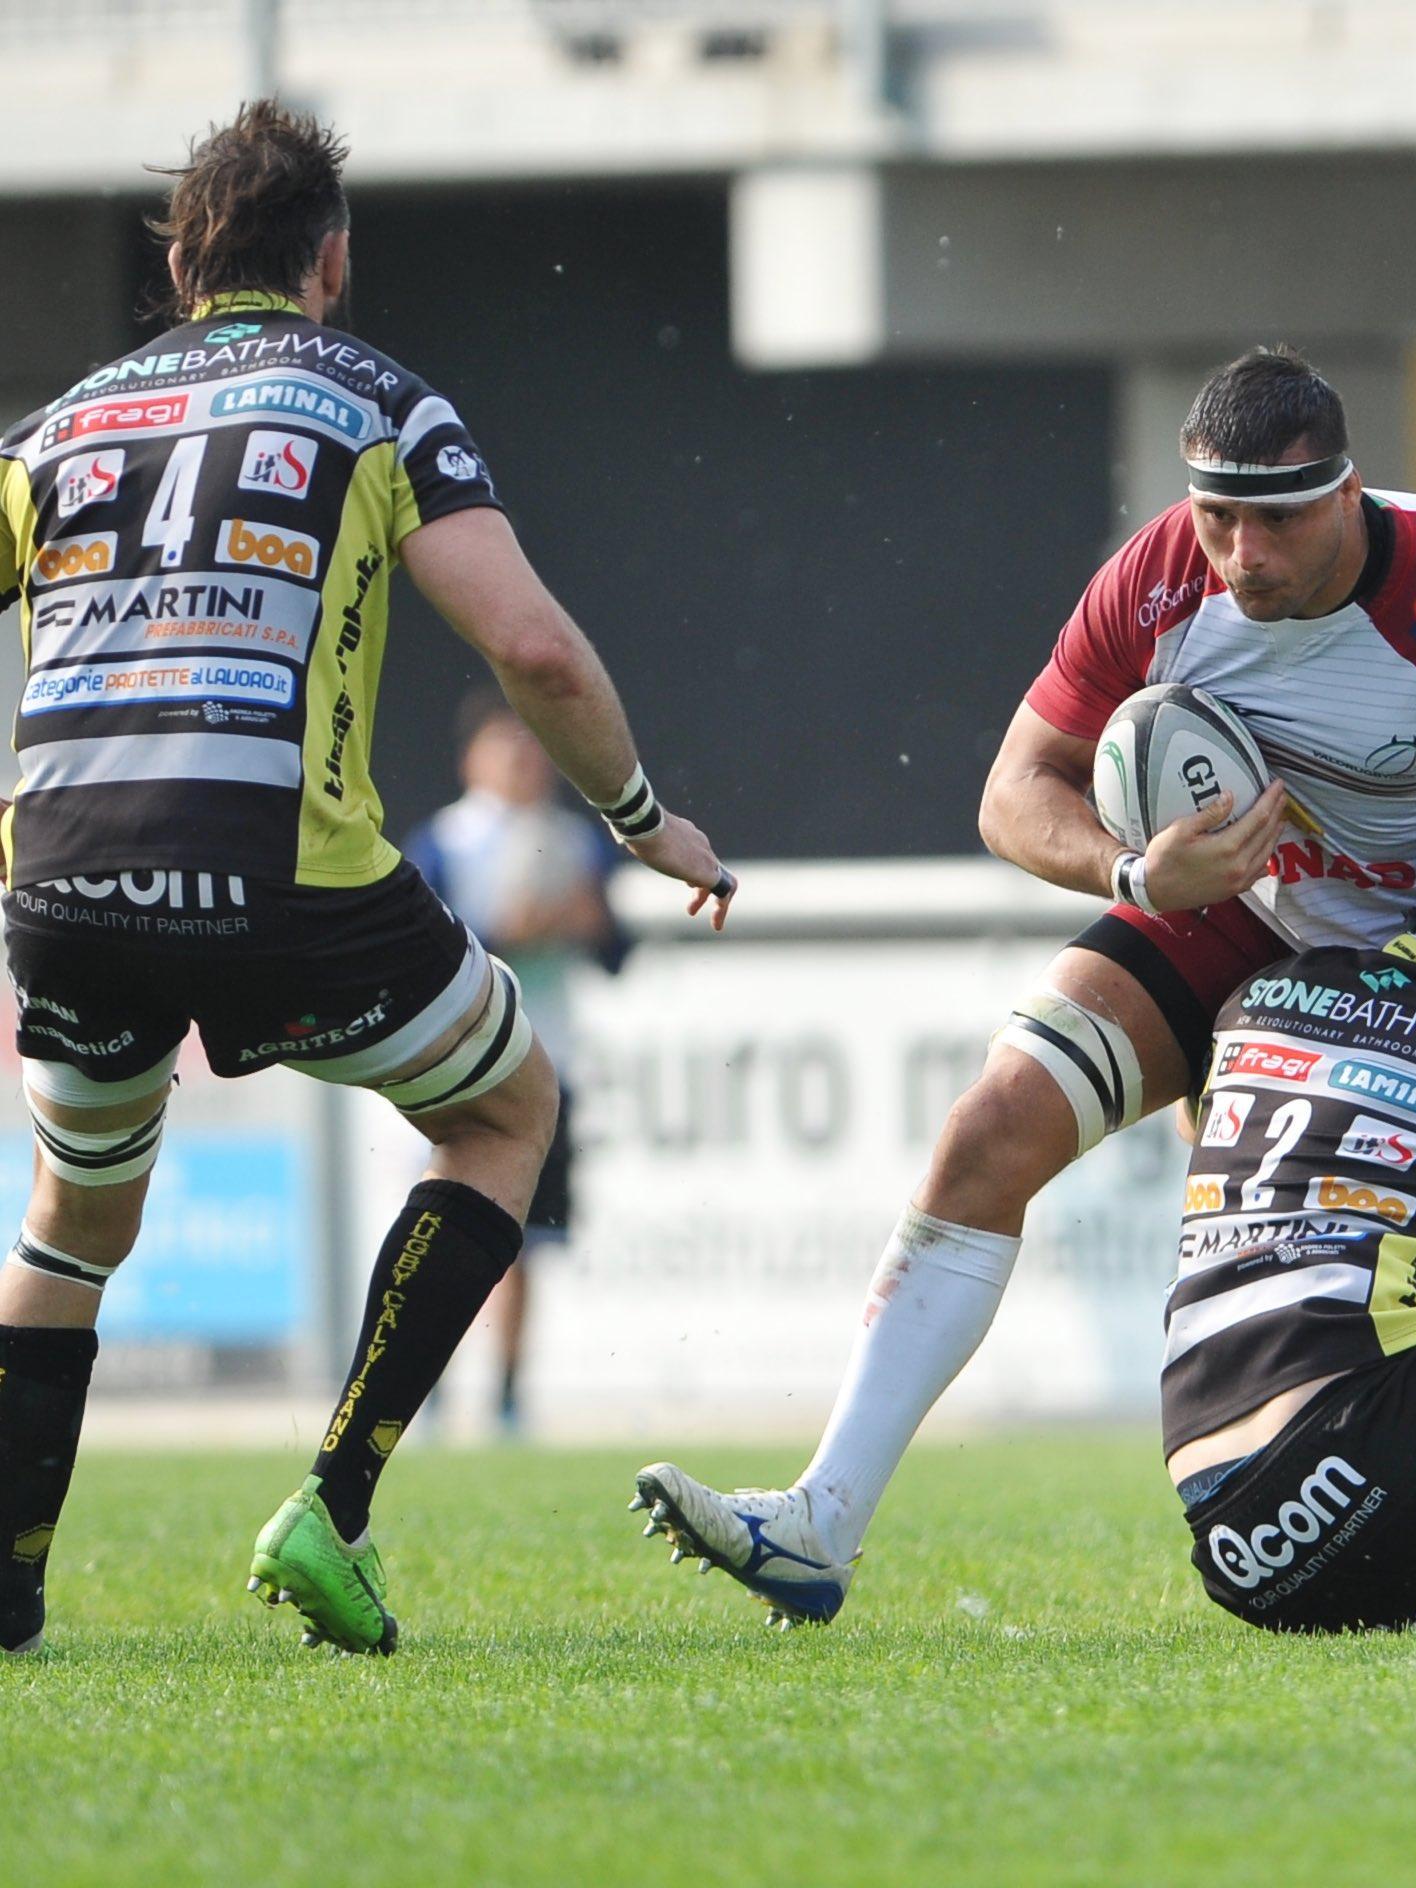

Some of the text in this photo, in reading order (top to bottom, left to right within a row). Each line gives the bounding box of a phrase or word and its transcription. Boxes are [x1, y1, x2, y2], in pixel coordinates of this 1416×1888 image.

[221, 356, 302, 377] BATHROOM
[80, 403, 182, 428] fragi
[223, 385, 349, 427] LAMINAL
[141, 433, 209, 568] 4
[228, 518, 313, 576] boa
[81, 585, 265, 627] MARTINI
[145, 621, 257, 640] PREFABBRICATI
[36, 869, 246, 908] com
[16, 890, 249, 935] YOUR QUALITY IT PARTNER
[239, 1003, 386, 1062] AGRITECH
[1255, 1015, 1346, 1041] REVOLUTIONARY
[1239, 1048, 1313, 1078] fragi
[1241, 1098, 1313, 1211] 2
[1317, 1175, 1408, 1223] boa
[392, 1211, 442, 1286] RUGBY
[322, 1290, 406, 1452] CALVISANO
[1208, 1455, 1368, 1589] Qcom
[1275, 1551, 1329, 1597] QUALITY
[1322, 1543, 1339, 1560] IT
[1332, 1486, 1389, 1547] PARTNER
